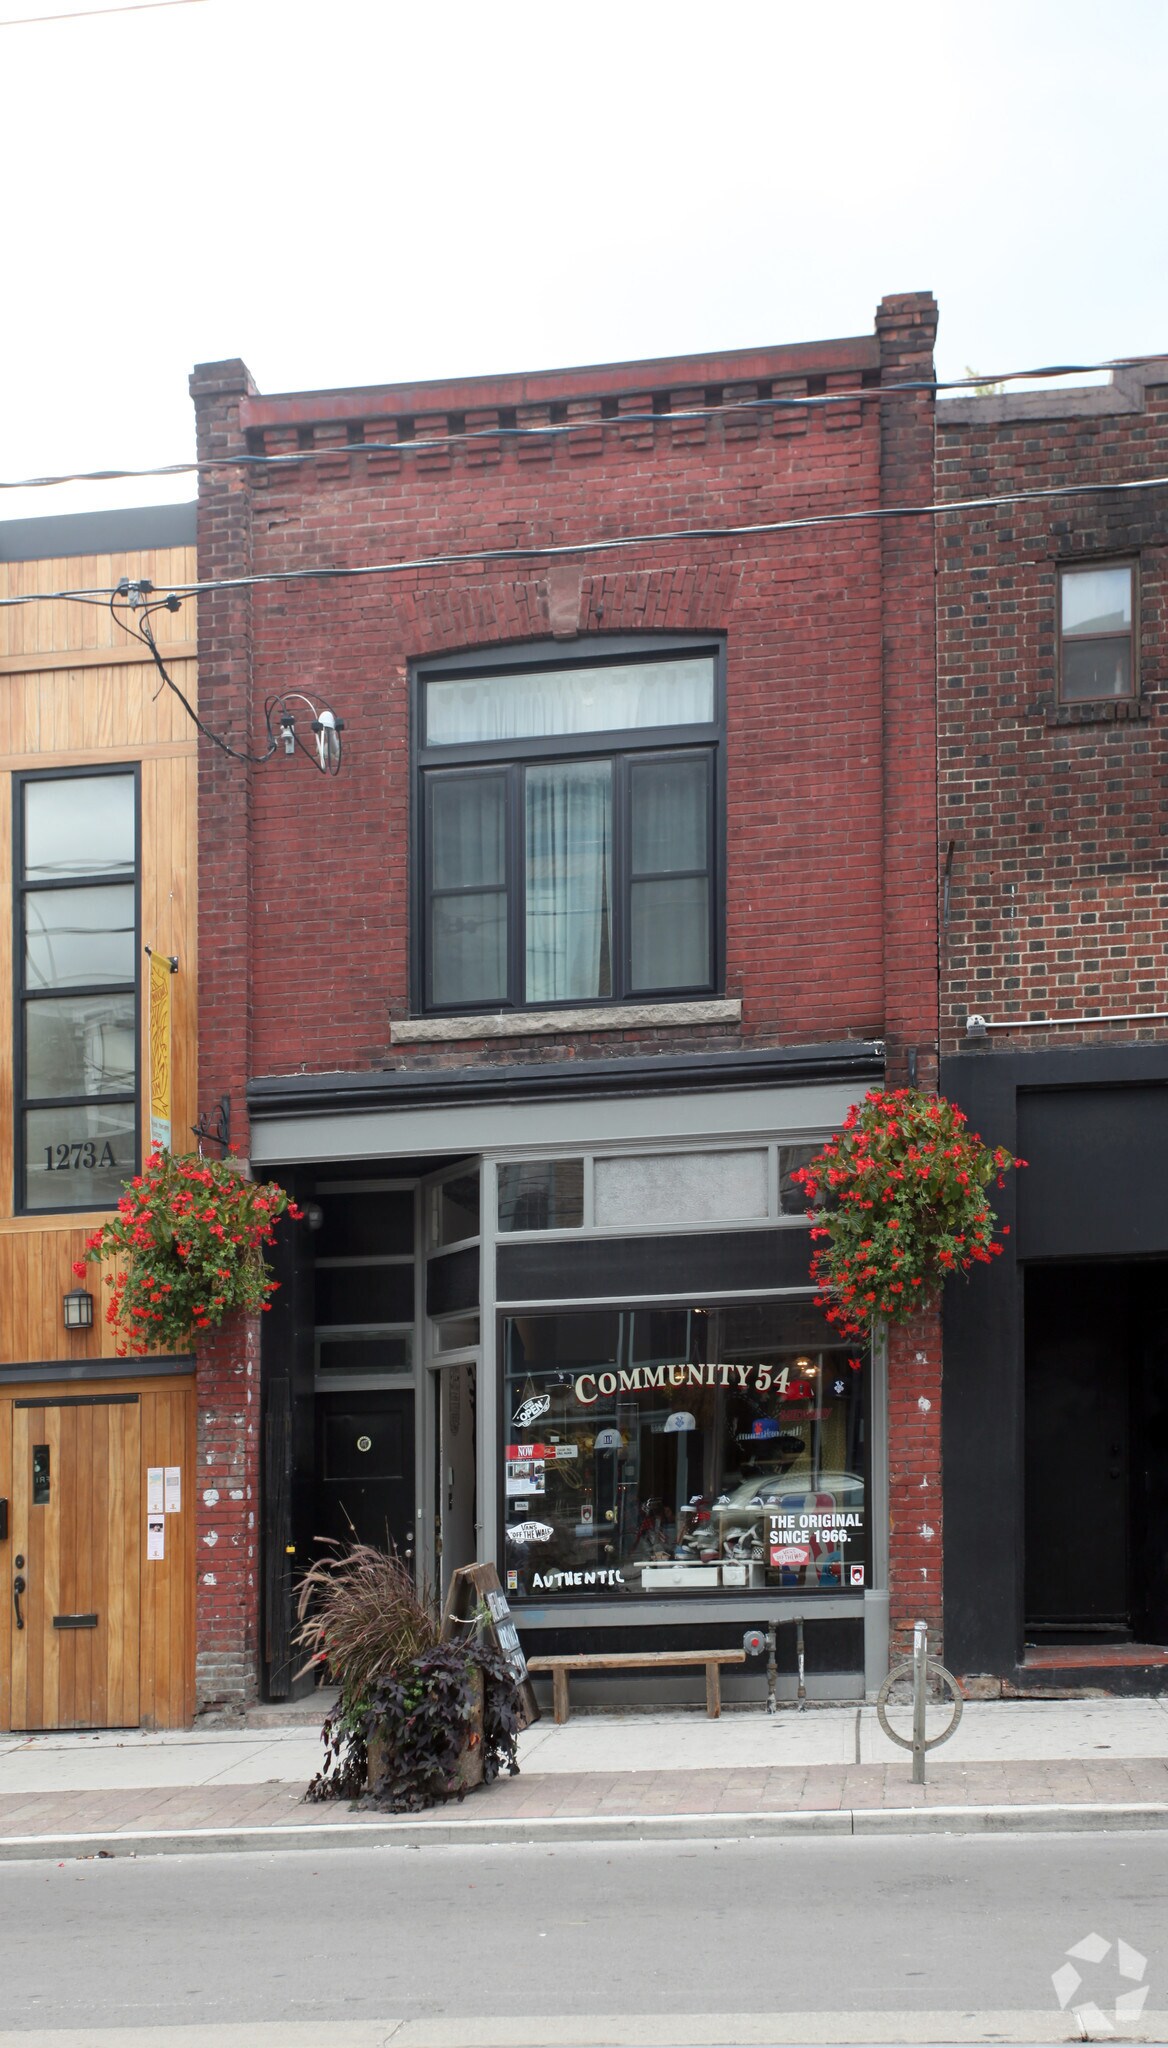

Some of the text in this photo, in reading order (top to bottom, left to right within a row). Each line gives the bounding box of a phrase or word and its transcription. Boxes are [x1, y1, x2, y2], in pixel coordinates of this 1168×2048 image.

[44, 1141, 118, 1171] 1273A
[575, 1363, 791, 1404] COMMUNITY 54
[519, 1400, 544, 1421] OPEN
[518, 1445, 534, 1457] NOW
[770, 1513, 863, 1529] THE ORIGINAL
[523, 1530, 535, 1539] THE
[769, 1529, 852, 1544] SINCE 1966.
